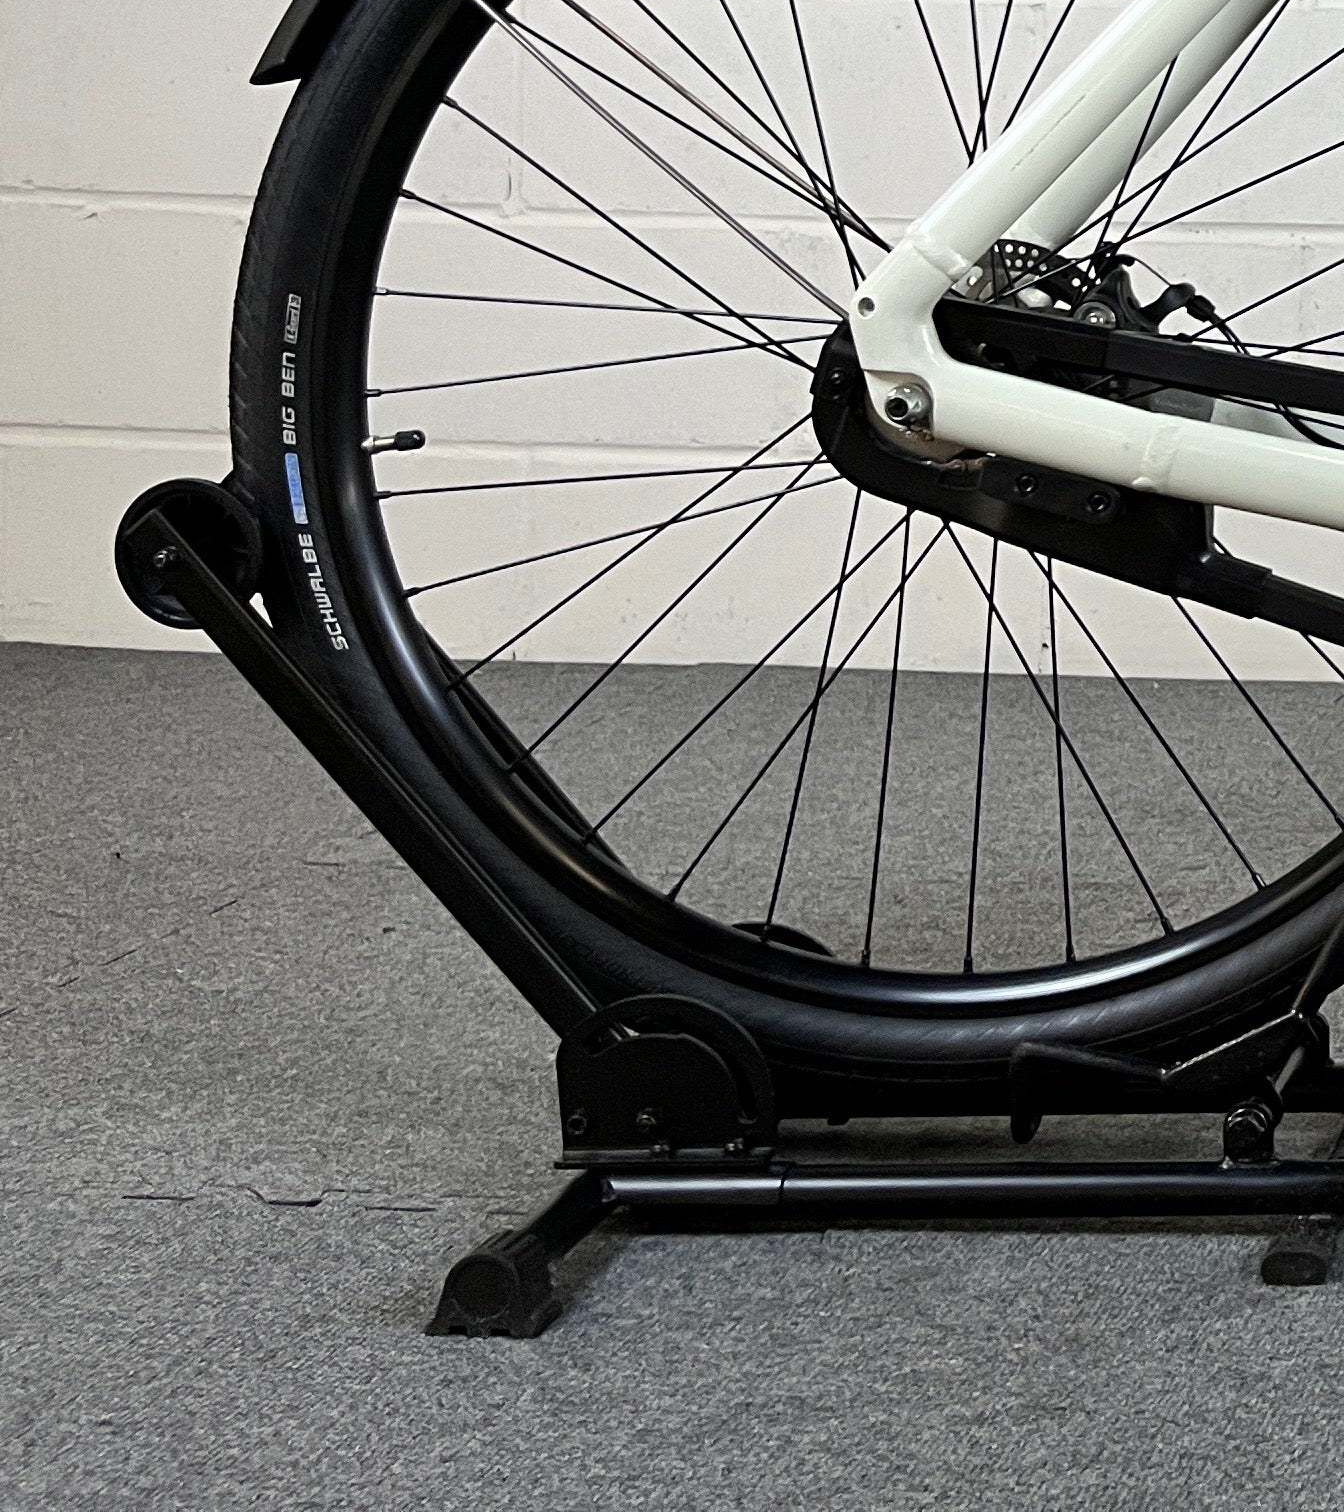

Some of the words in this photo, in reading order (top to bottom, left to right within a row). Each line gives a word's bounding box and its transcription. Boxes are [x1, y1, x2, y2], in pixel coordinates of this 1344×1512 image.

[281, 352, 296, 399] BEN
[282, 405, 297, 445] BIG
[298, 533, 349, 651] SCHWALBE
